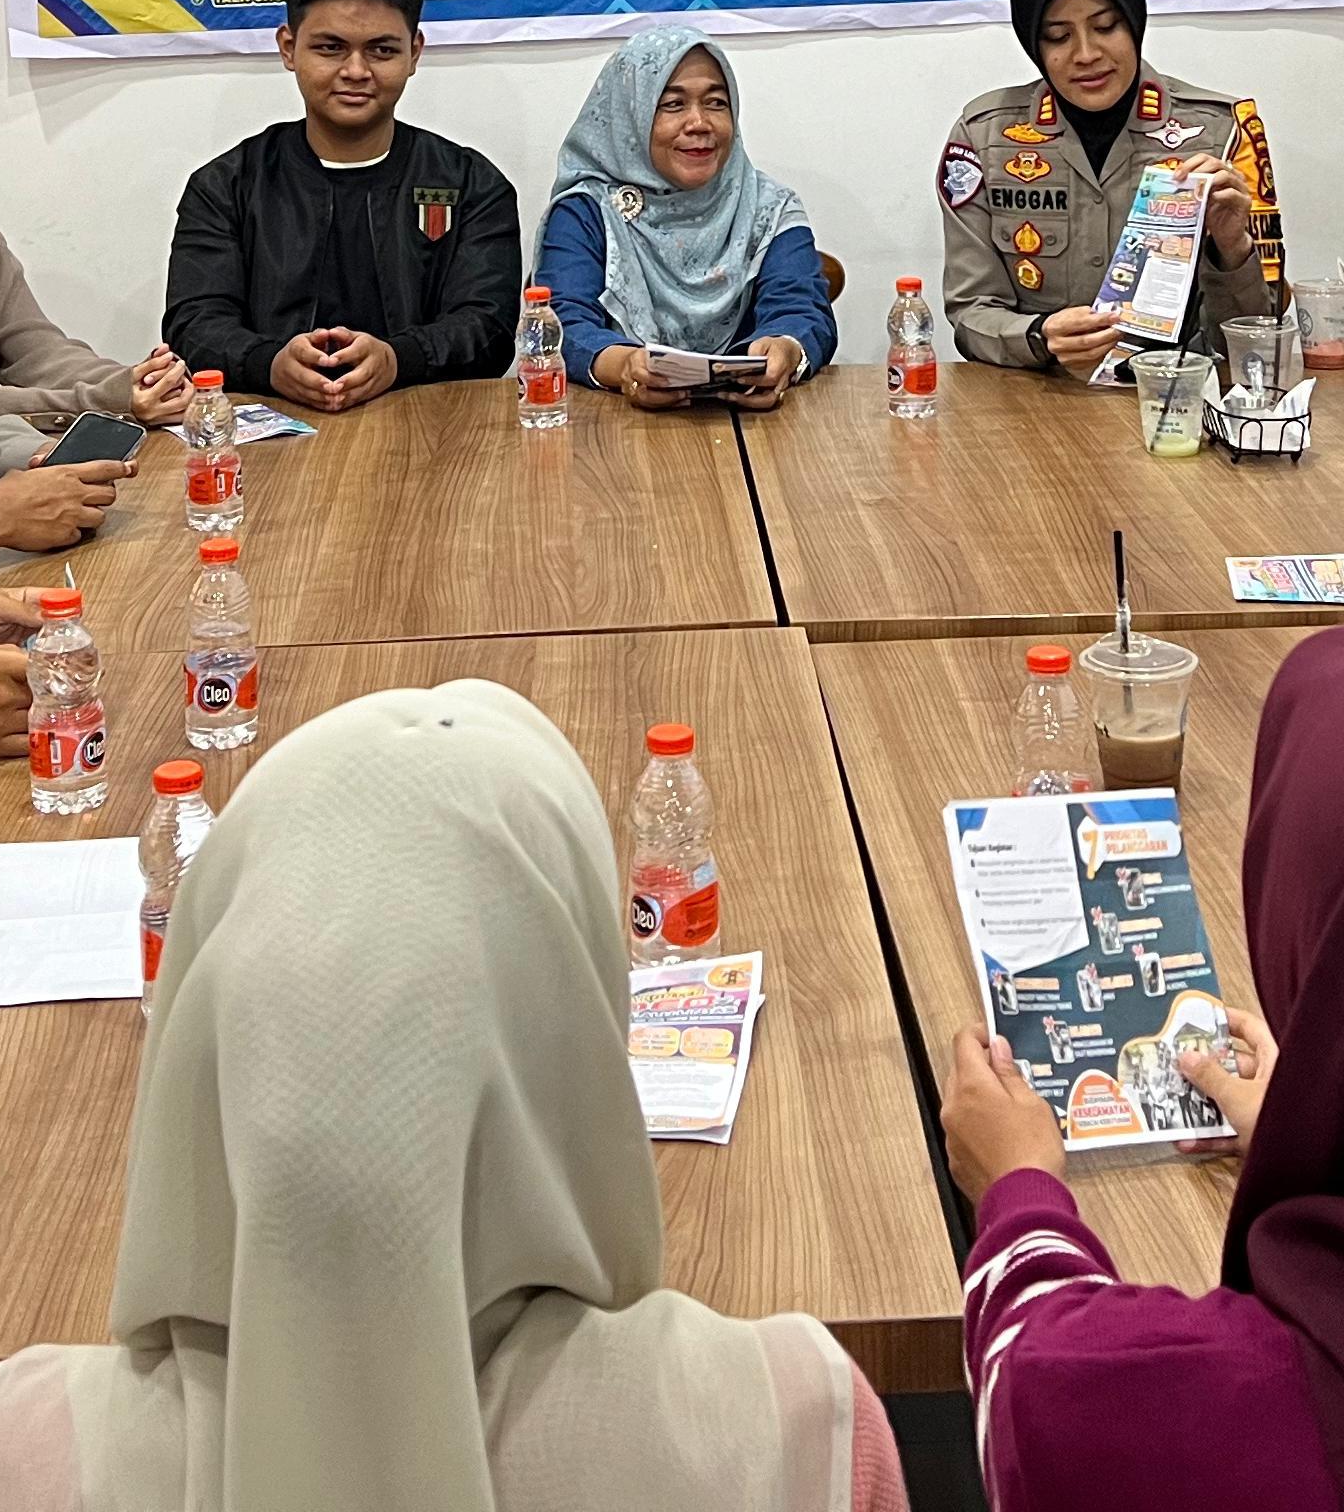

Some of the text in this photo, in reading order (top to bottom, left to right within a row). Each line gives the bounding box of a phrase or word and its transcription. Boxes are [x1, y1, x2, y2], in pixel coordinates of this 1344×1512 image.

[991, 188, 1068, 210] ENGGAR
[203, 685, 230, 703] Cleo
[87, 739, 105, 760] Cle
